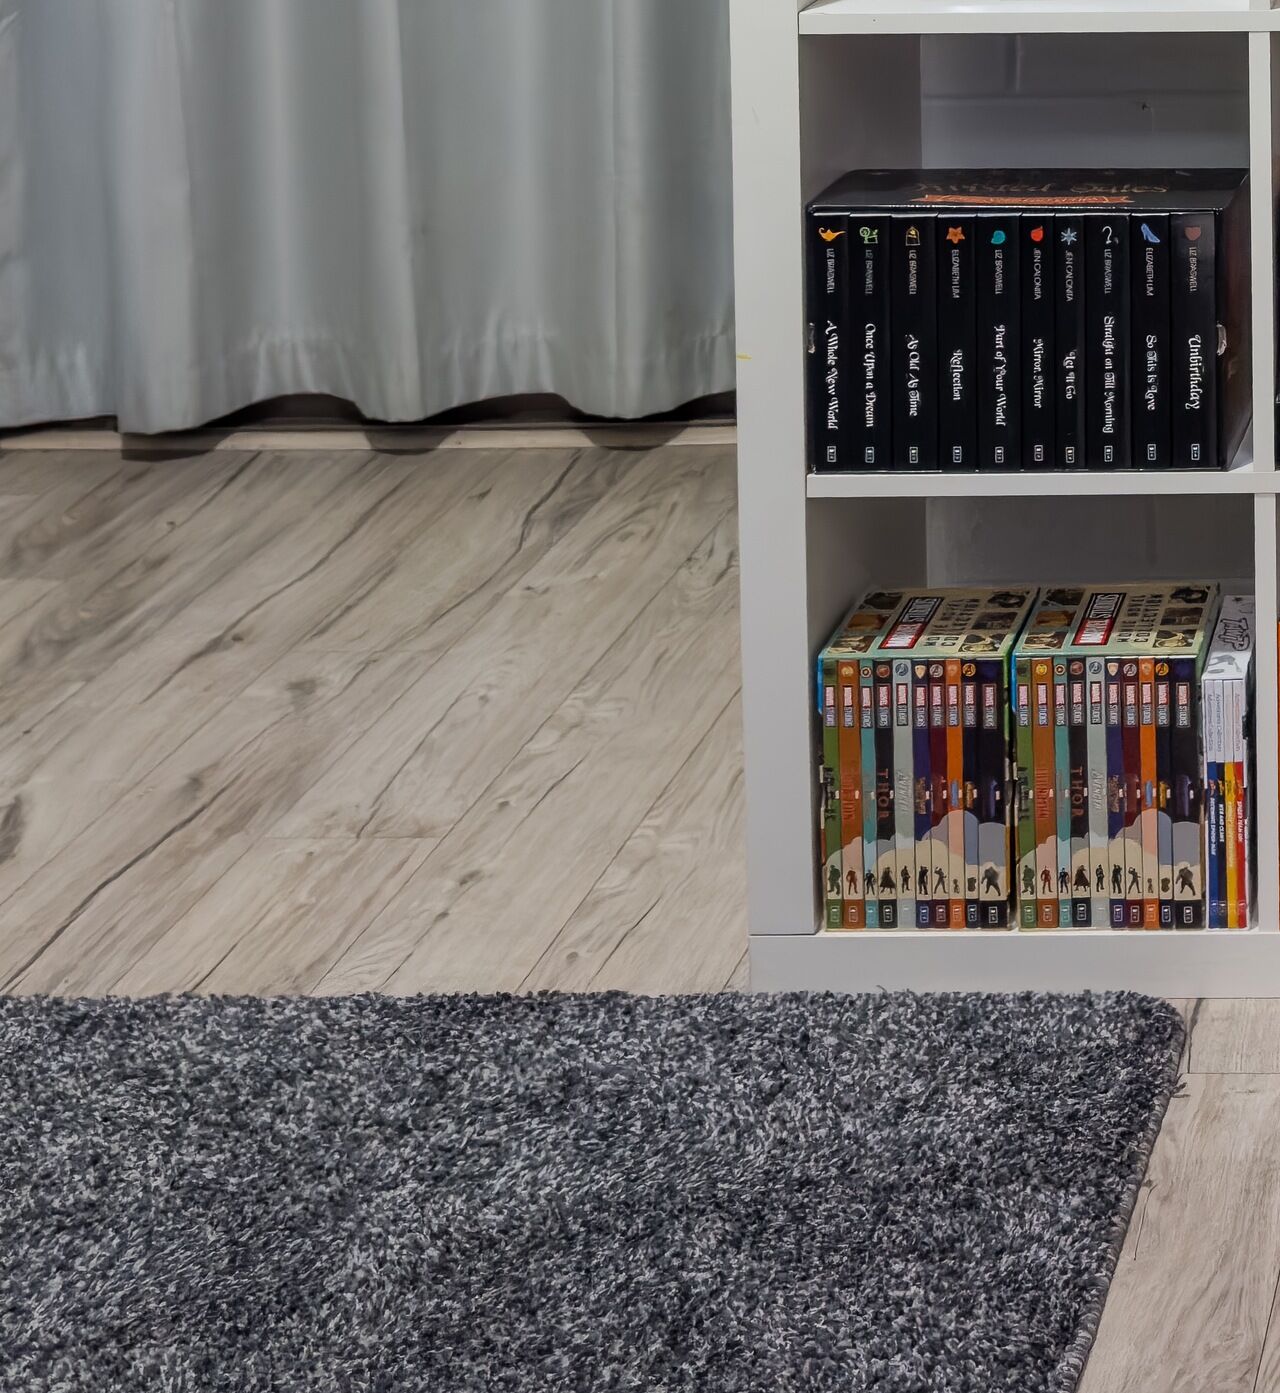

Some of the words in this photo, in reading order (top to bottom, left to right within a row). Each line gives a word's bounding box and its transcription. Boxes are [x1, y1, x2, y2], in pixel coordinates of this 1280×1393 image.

[826, 333, 839, 365] Whole
[865, 323, 876, 349] Once
[994, 324, 1006, 349] Part
[1102, 315, 1115, 355] Straight
[1146, 334, 1157, 348] So
[863, 351, 876, 379] Upon
[994, 351, 1006, 363] of
[1104, 358, 1113, 369] on
[1146, 350, 1157, 372] This
[1185, 334, 1203, 410] Unbirthday
[825, 368, 838, 394] New
[950, 349, 964, 400] Reflection
[1104, 372, 1115, 389] Till
[1033, 375, 1044, 408] Mirror
[1145, 384, 1157, 411] Love
[827, 397, 839, 429] World
[865, 391, 876, 427] Dream
[995, 393, 1006, 426] World
[1102, 391, 1115, 433] Morning
[1071, 766, 1083, 817] THOR
